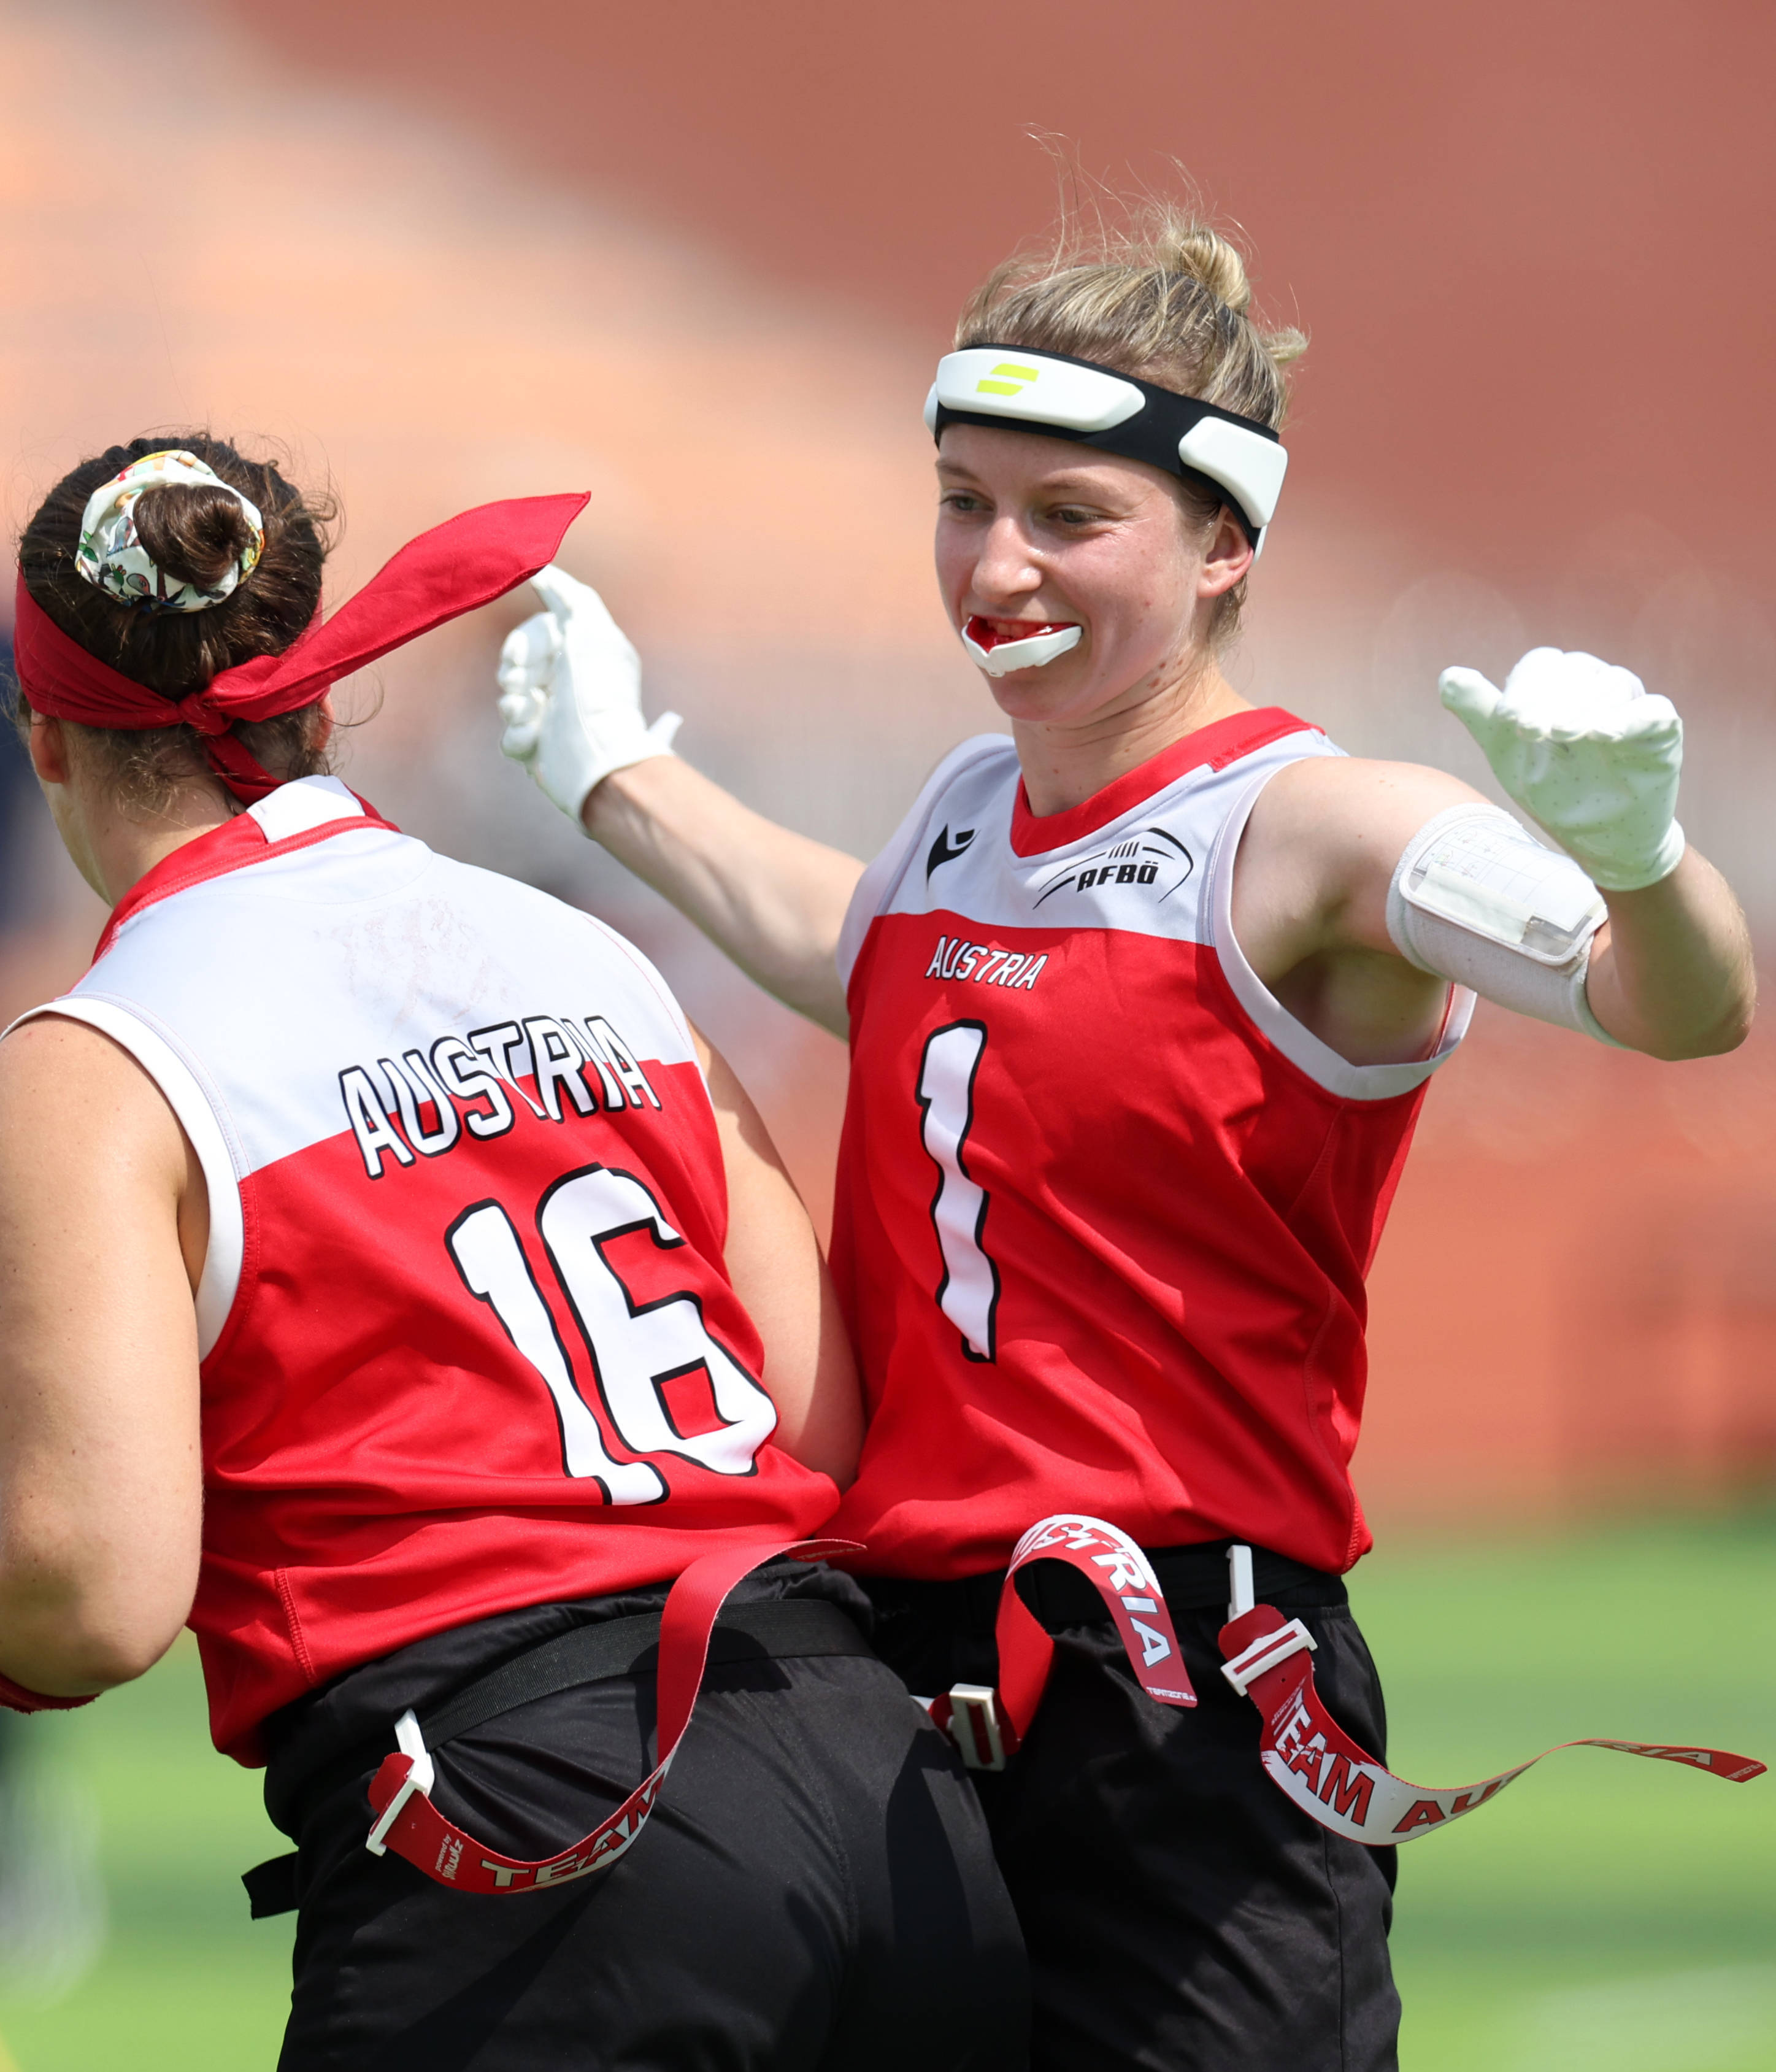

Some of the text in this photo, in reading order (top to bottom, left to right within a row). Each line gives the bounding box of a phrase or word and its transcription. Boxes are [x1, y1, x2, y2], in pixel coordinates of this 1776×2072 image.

[1077, 860, 1159, 893] AFBÖ
[925, 935, 1048, 990] AUSTRIA
[338, 1015, 662, 1180] AUSTRIA
[915, 1019, 1001, 1365] 1
[444, 1162, 778, 1506] 16
[481, 1770, 666, 1887] TEAM
